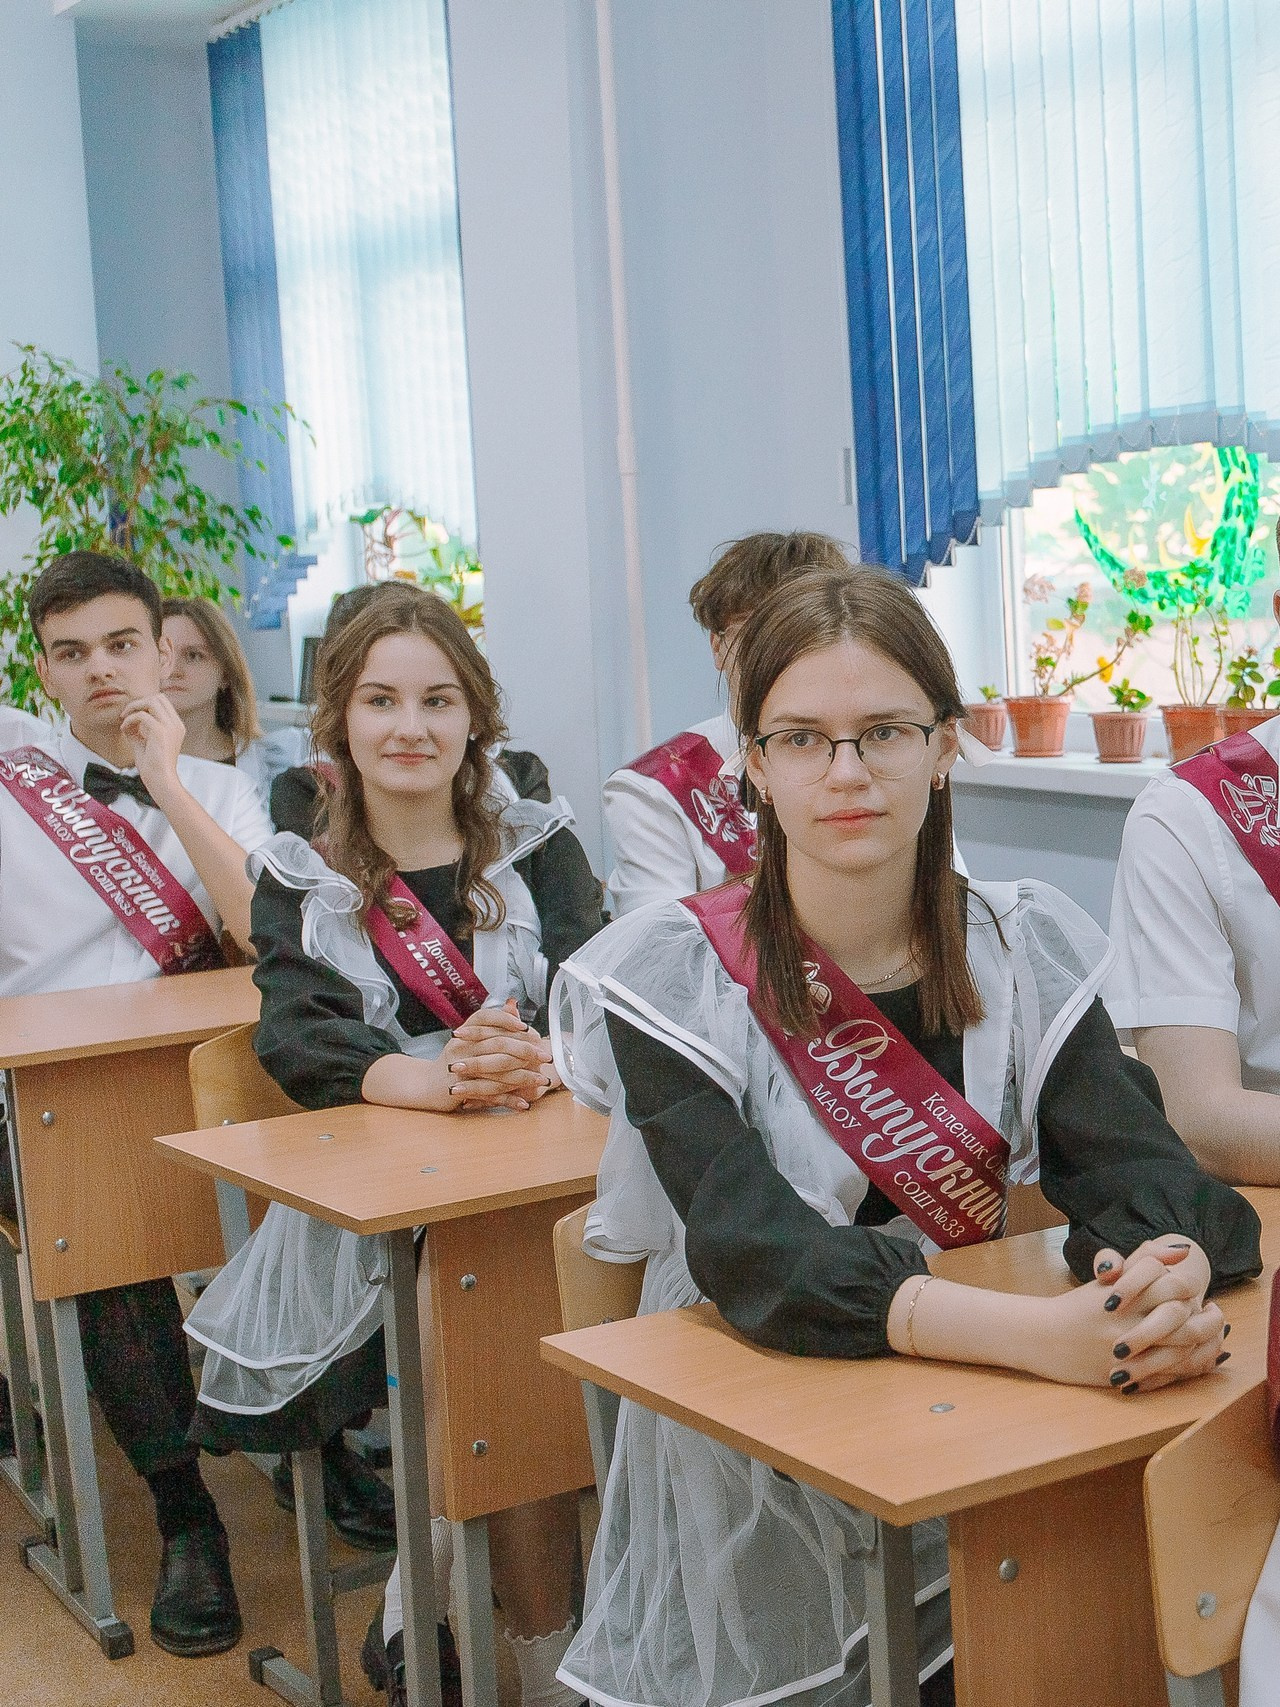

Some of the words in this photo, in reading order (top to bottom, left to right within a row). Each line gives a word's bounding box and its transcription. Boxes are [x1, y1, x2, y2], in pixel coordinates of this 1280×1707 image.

[41, 778, 182, 936] Выпускник
[43, 814, 75, 843] МАОУ
[89, 865, 116, 894] СОШ
[420, 938, 465, 990] Донская
[808, 1082, 862, 1131] МАОУ
[893, 1170, 937, 1211] СОШ
[928, 1204, 966, 1238] №33
[921, 1091, 989, 1160] Каленик
